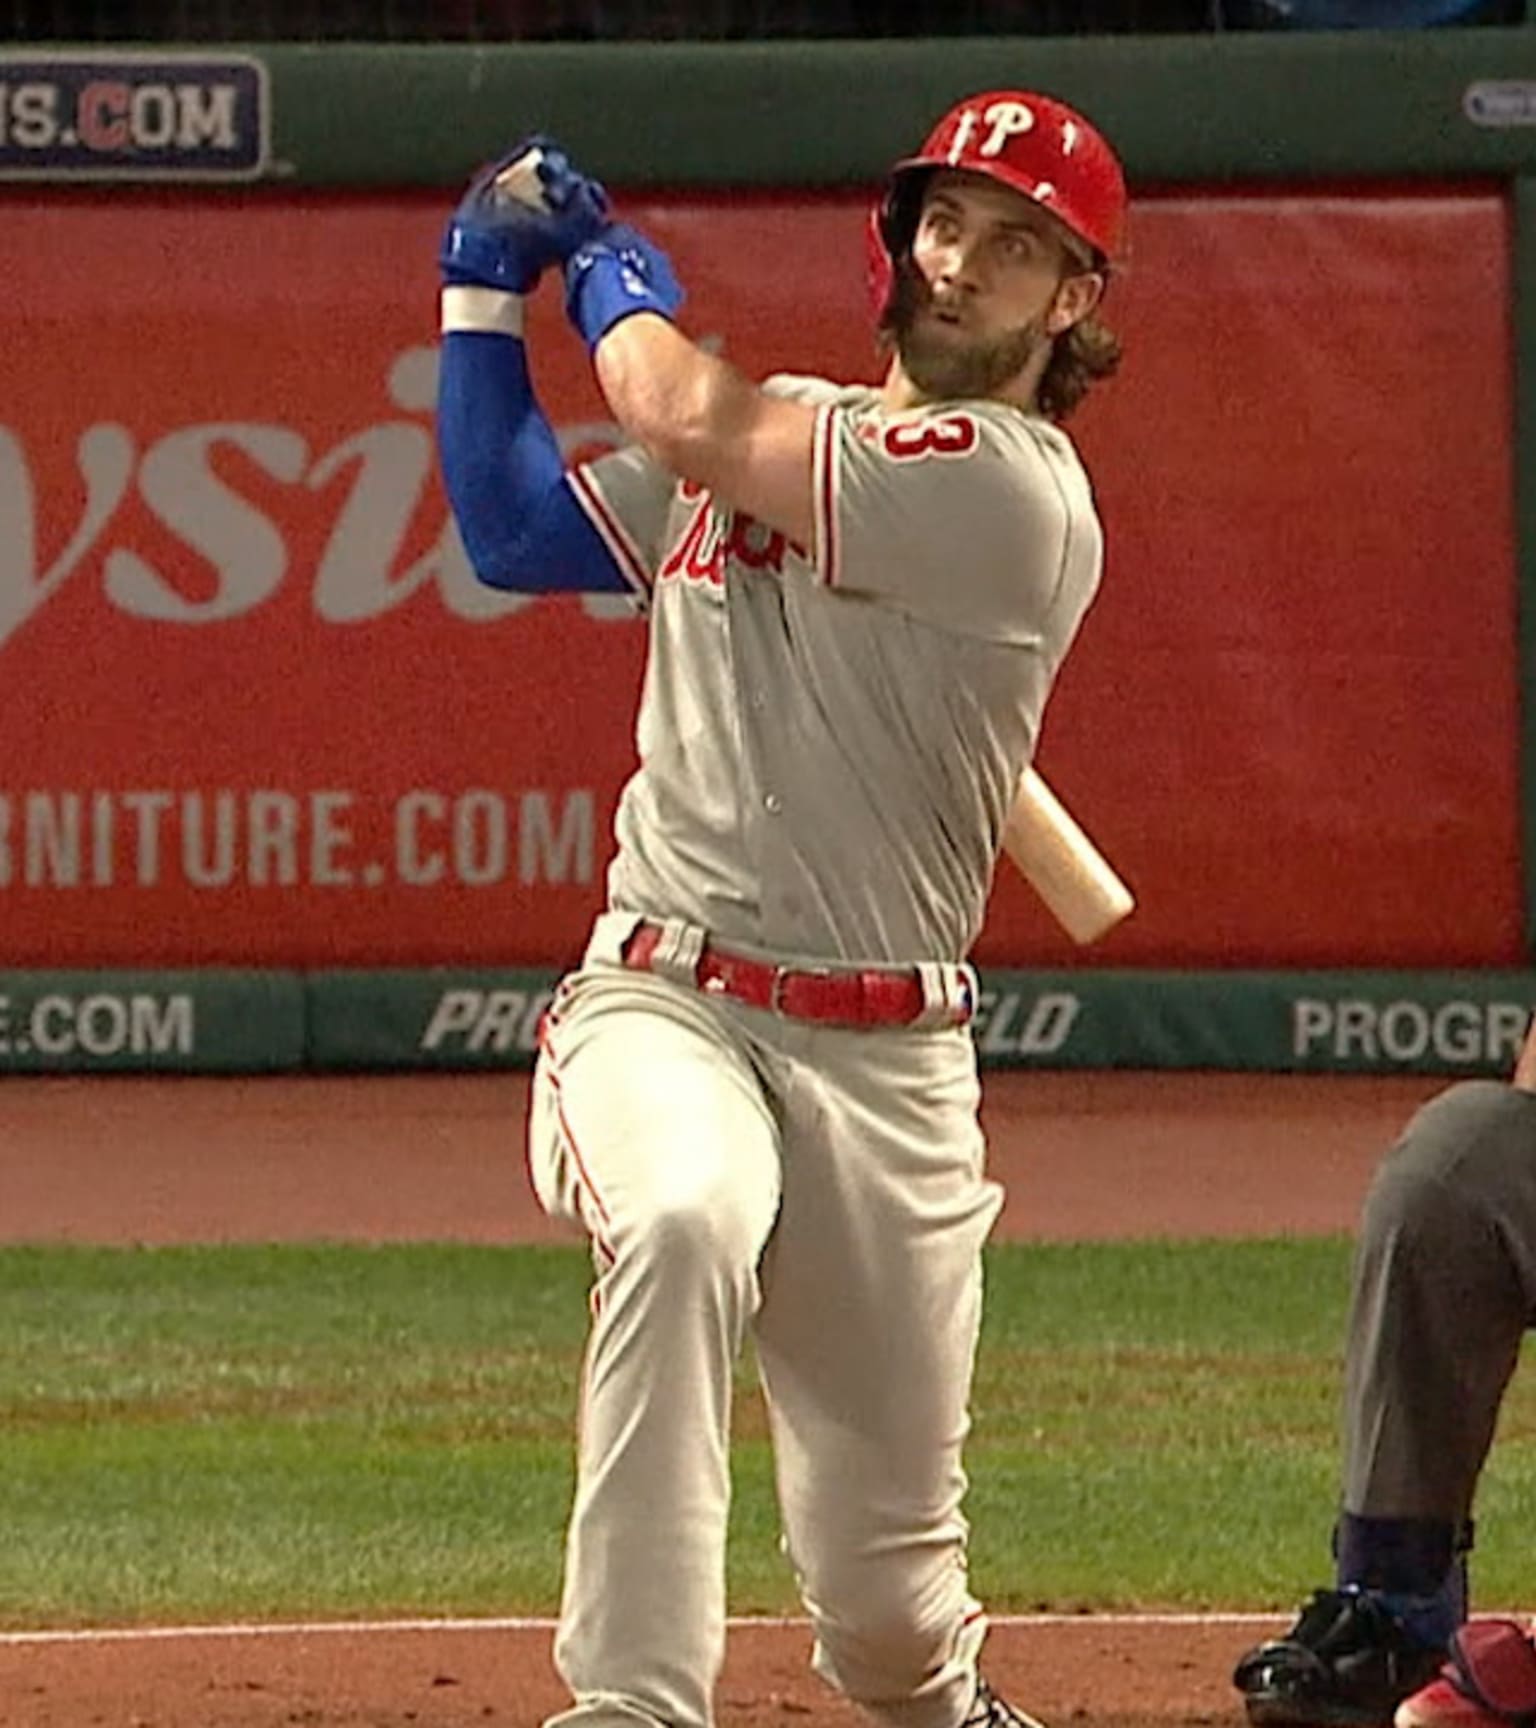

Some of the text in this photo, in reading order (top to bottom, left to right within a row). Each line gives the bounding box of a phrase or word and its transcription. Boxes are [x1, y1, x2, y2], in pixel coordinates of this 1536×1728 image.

[0, 80, 236, 150] S.COM
[980, 102, 1034, 157] P
[882, 411, 978, 461] 3
[0, 788, 595, 887] NITURE.COM
[0, 994, 194, 1055] .COM
